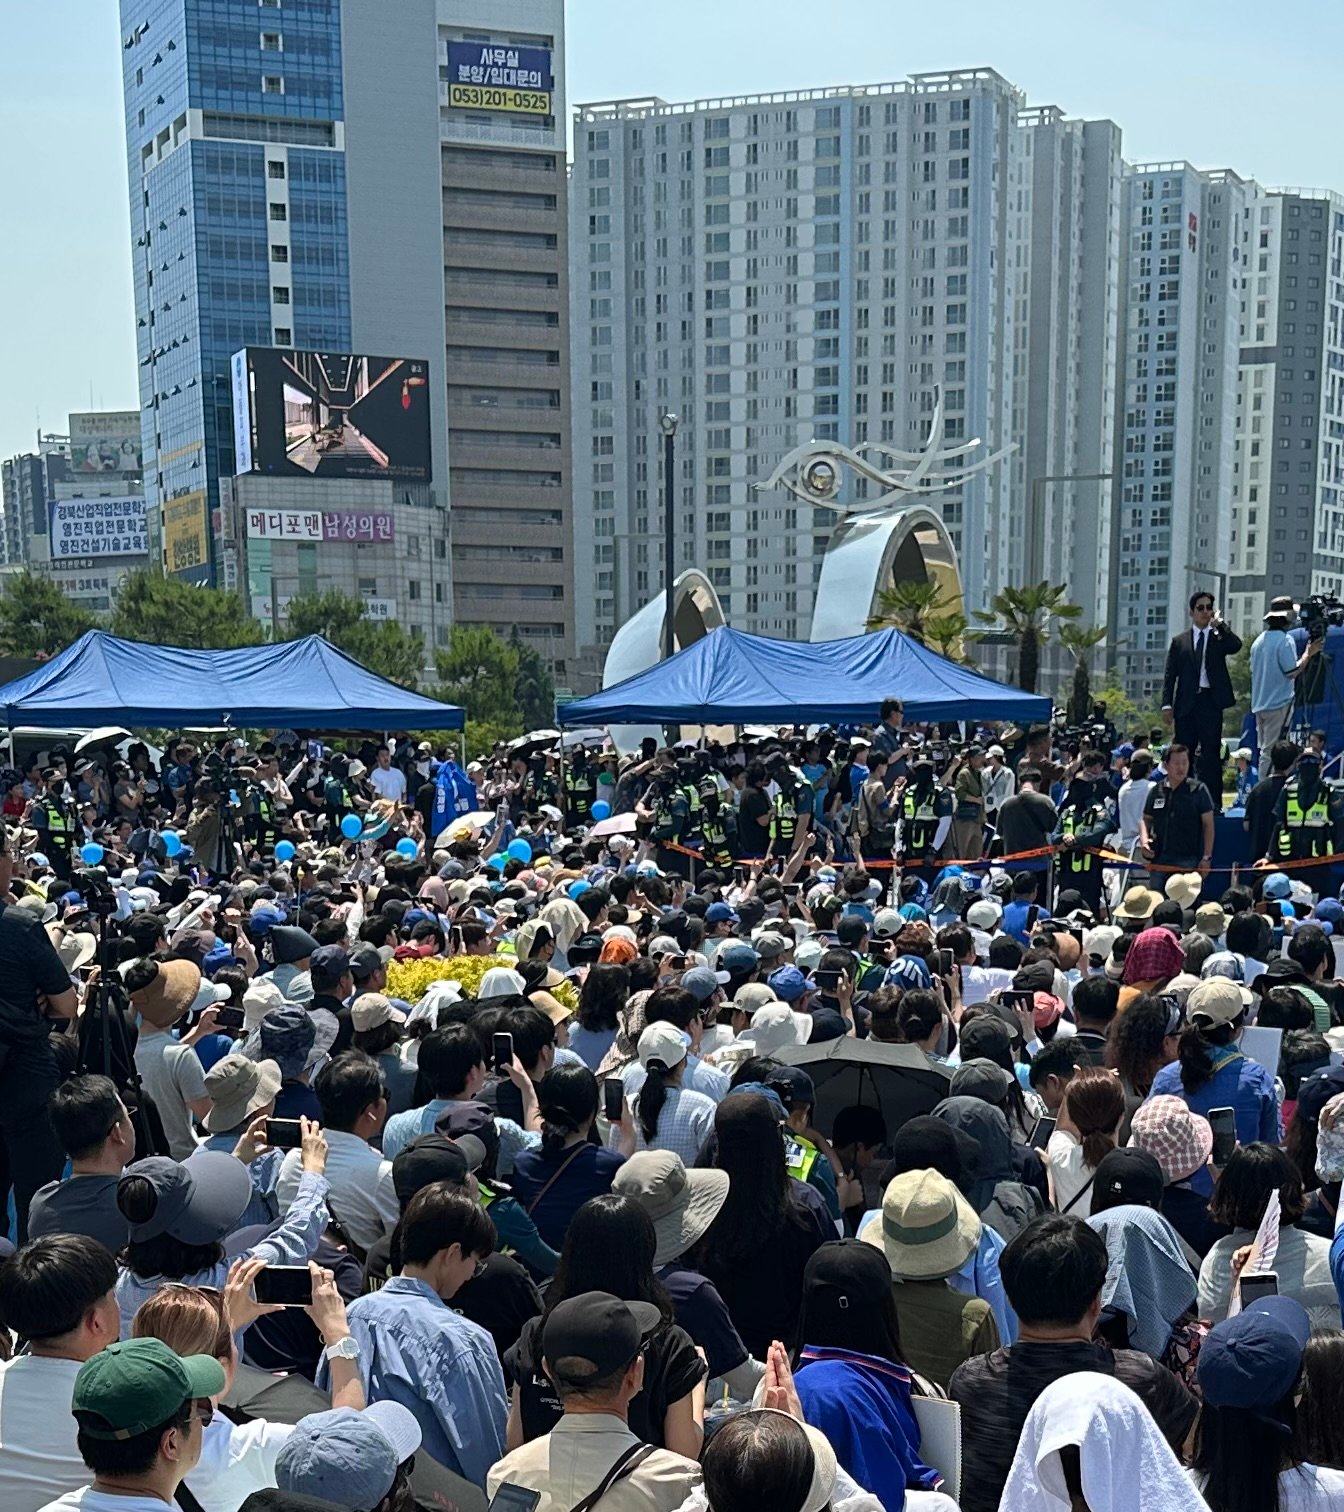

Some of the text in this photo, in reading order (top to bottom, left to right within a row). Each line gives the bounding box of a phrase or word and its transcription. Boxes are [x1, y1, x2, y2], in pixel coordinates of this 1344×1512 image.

[480, 48, 519, 67] 사무실
[458, 64, 542, 88] 분양/임대문의
[452, 87, 548, 110] 053)201-0525
[250, 512, 393, 541] 메디포맨 남성의원
